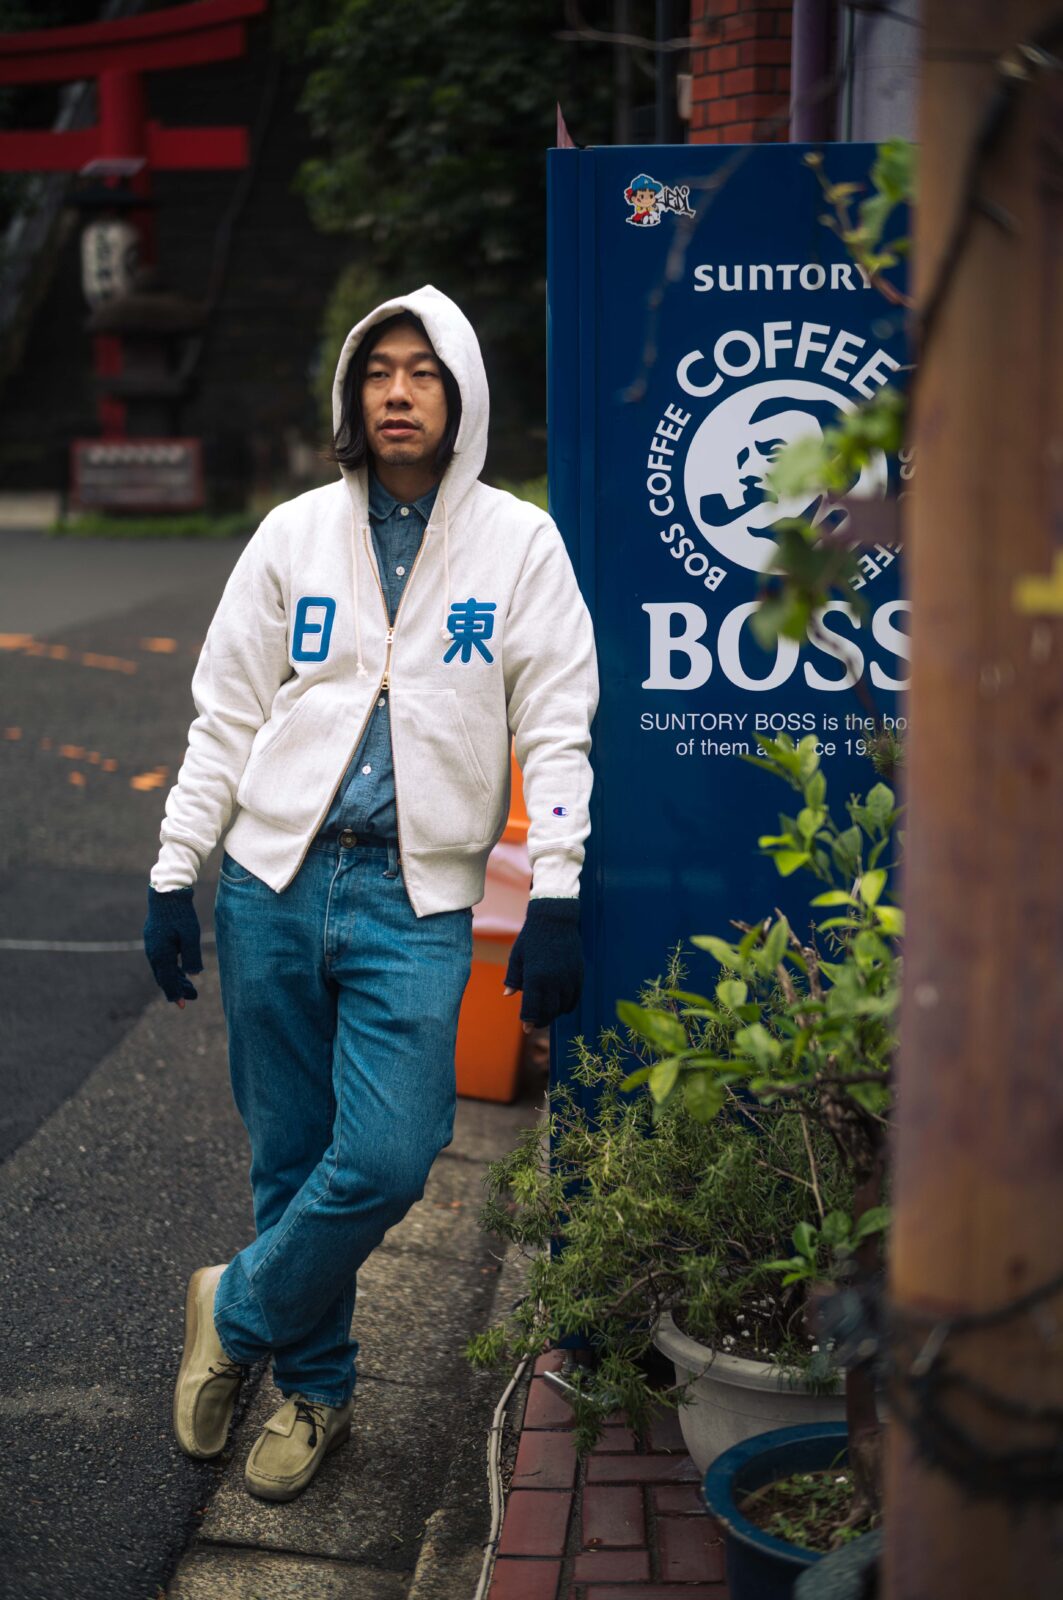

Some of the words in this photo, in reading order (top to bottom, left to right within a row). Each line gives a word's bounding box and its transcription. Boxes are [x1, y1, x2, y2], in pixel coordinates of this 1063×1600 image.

[693, 263, 880, 292] SUNTORY
[676, 321, 901, 400] COFFEE
[647, 403, 691, 516] COFFEE
[660, 523, 727, 591] BOSS
[292, 597, 336, 662] 日
[443, 597, 497, 664] 東
[641, 600, 912, 691] BOSS
[640, 712, 748, 730] SUNTORY
[755, 712, 816, 730] BOSS
[823, 713, 839, 730] is
[844, 713, 875, 730] the
[675, 738, 695, 756] of
[700, 738, 749, 756] them
